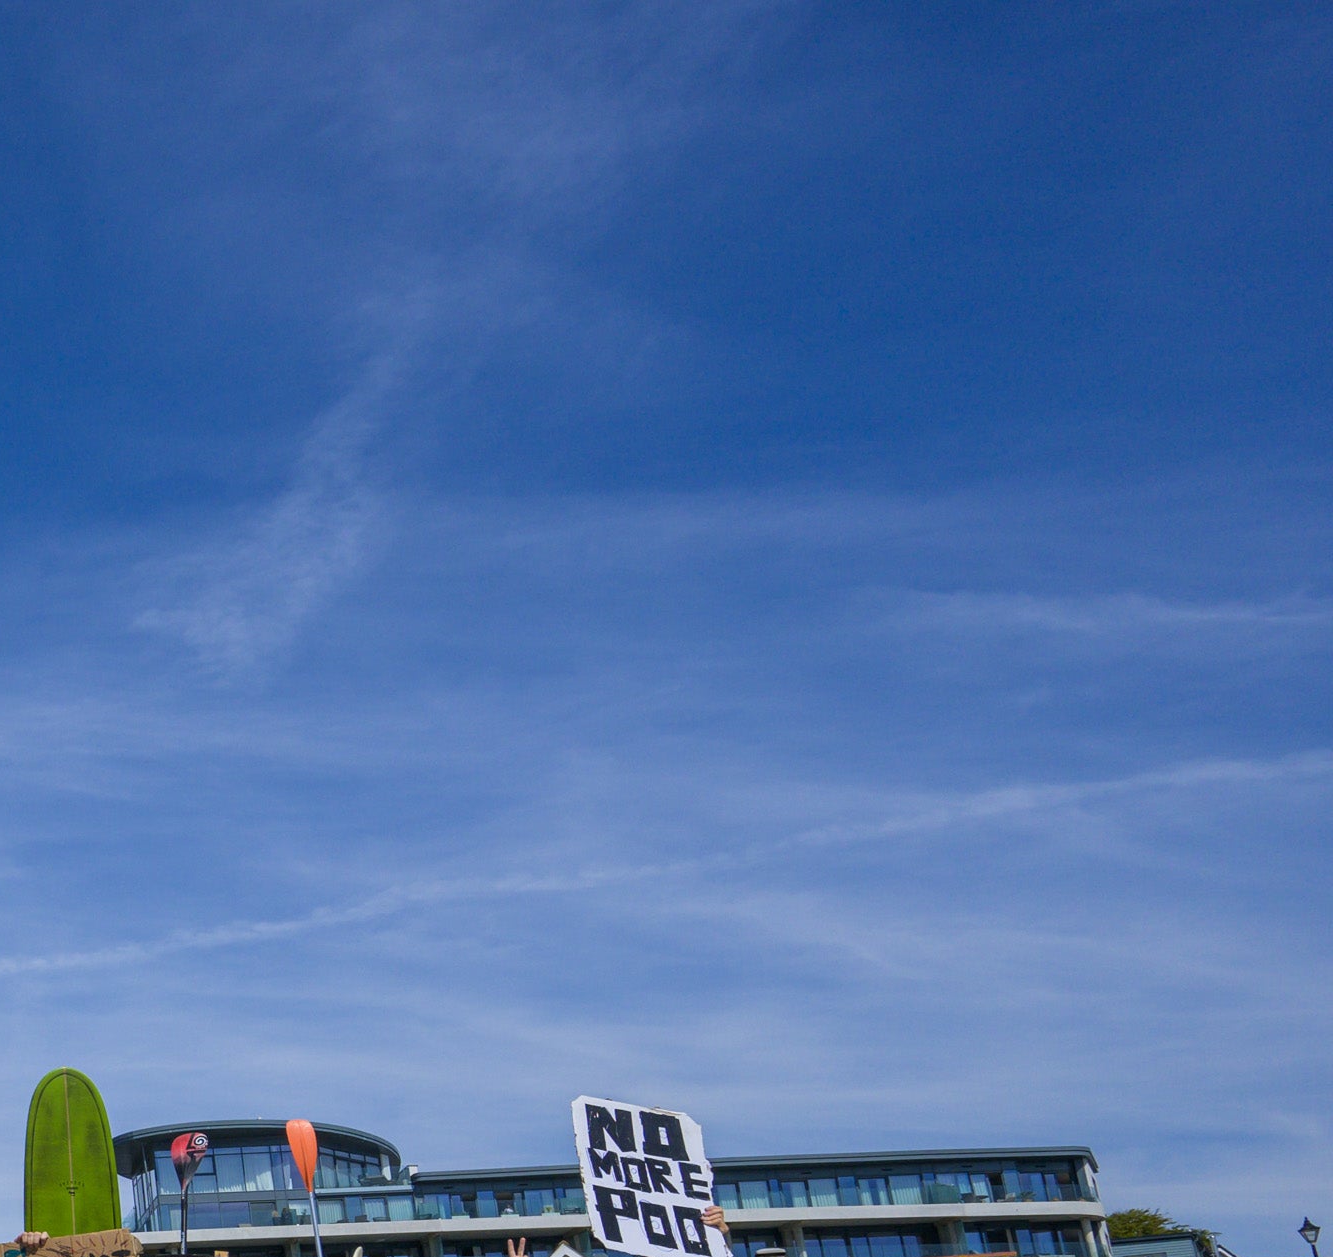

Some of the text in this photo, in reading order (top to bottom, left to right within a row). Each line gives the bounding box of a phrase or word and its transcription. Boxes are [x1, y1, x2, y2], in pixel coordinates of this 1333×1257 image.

[585, 1104, 689, 1161] NO
[588, 1148, 711, 1200] MORE
[593, 1185, 712, 1257] POO
